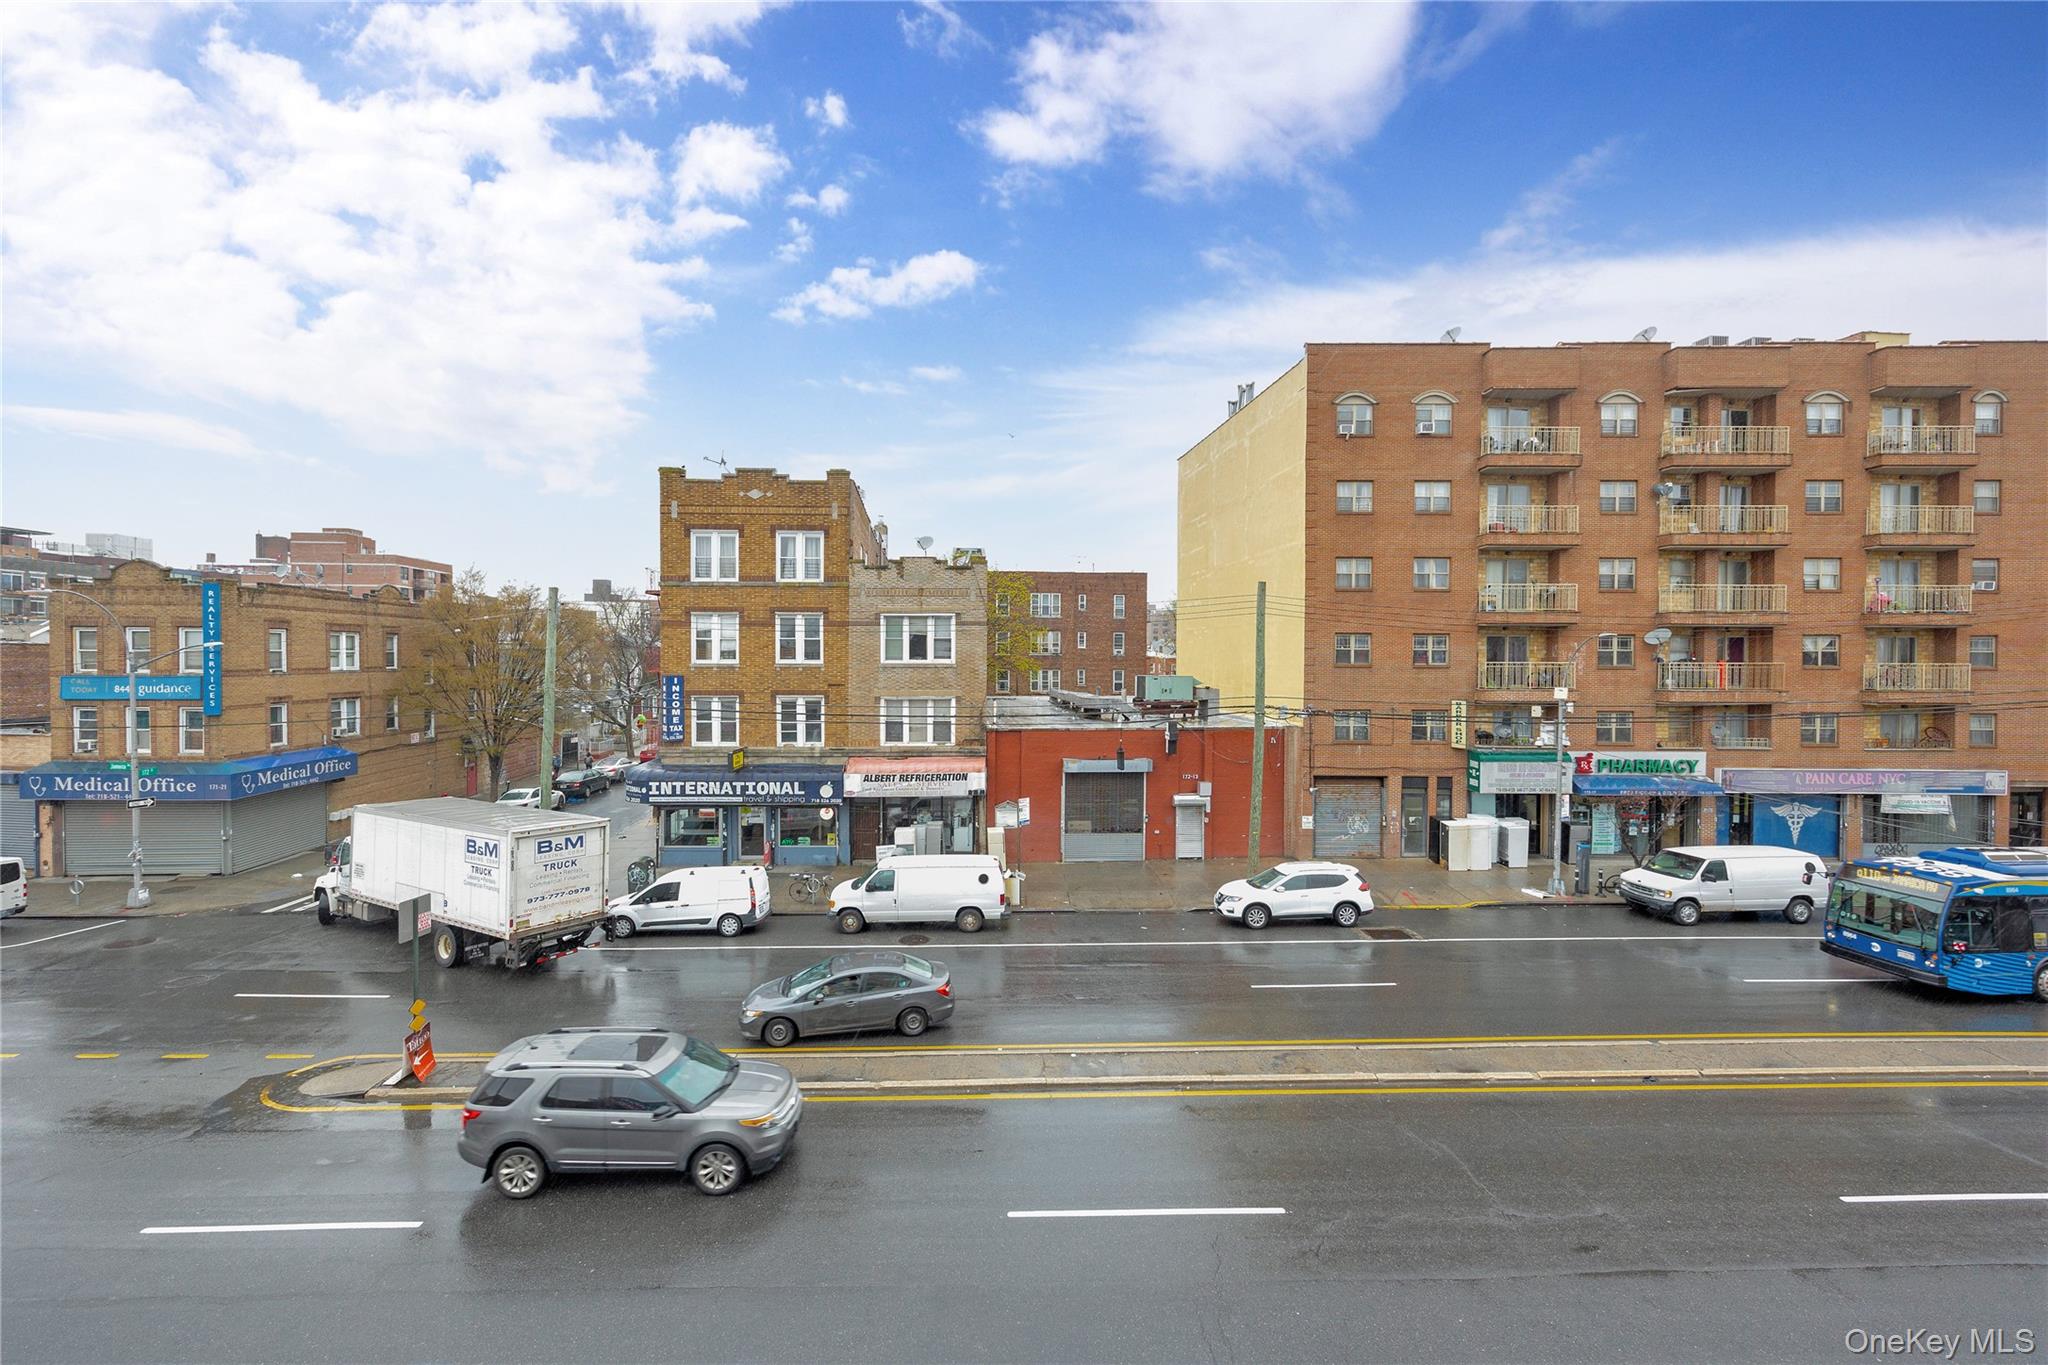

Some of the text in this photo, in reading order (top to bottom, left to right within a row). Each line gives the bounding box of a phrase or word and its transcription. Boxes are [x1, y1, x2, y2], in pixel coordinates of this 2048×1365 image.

[138, 683, 192, 697] guidance
[671, 677, 680, 724] INCOME
[257, 759, 352, 786] Medical Office
[1597, 758, 1700, 774] PHARMACY
[54, 776, 197, 792] Medical Office
[863, 772, 968, 782] ALBERT REFRIGERATION
[1805, 772, 1836, 785] PAIN
[1878, 773, 1906, 785] NYC
[209, 783, 227, 791] 171-21
[648, 781, 805, 795] INTERNATIONAL
[744, 795, 765, 803] travel
[775, 795, 805, 803] shipping
[466, 838, 498, 858] B&M
[537, 835, 584, 854] B&M
[471, 865, 492, 877] TRUCK
[543, 859, 577, 872] TRUCK
